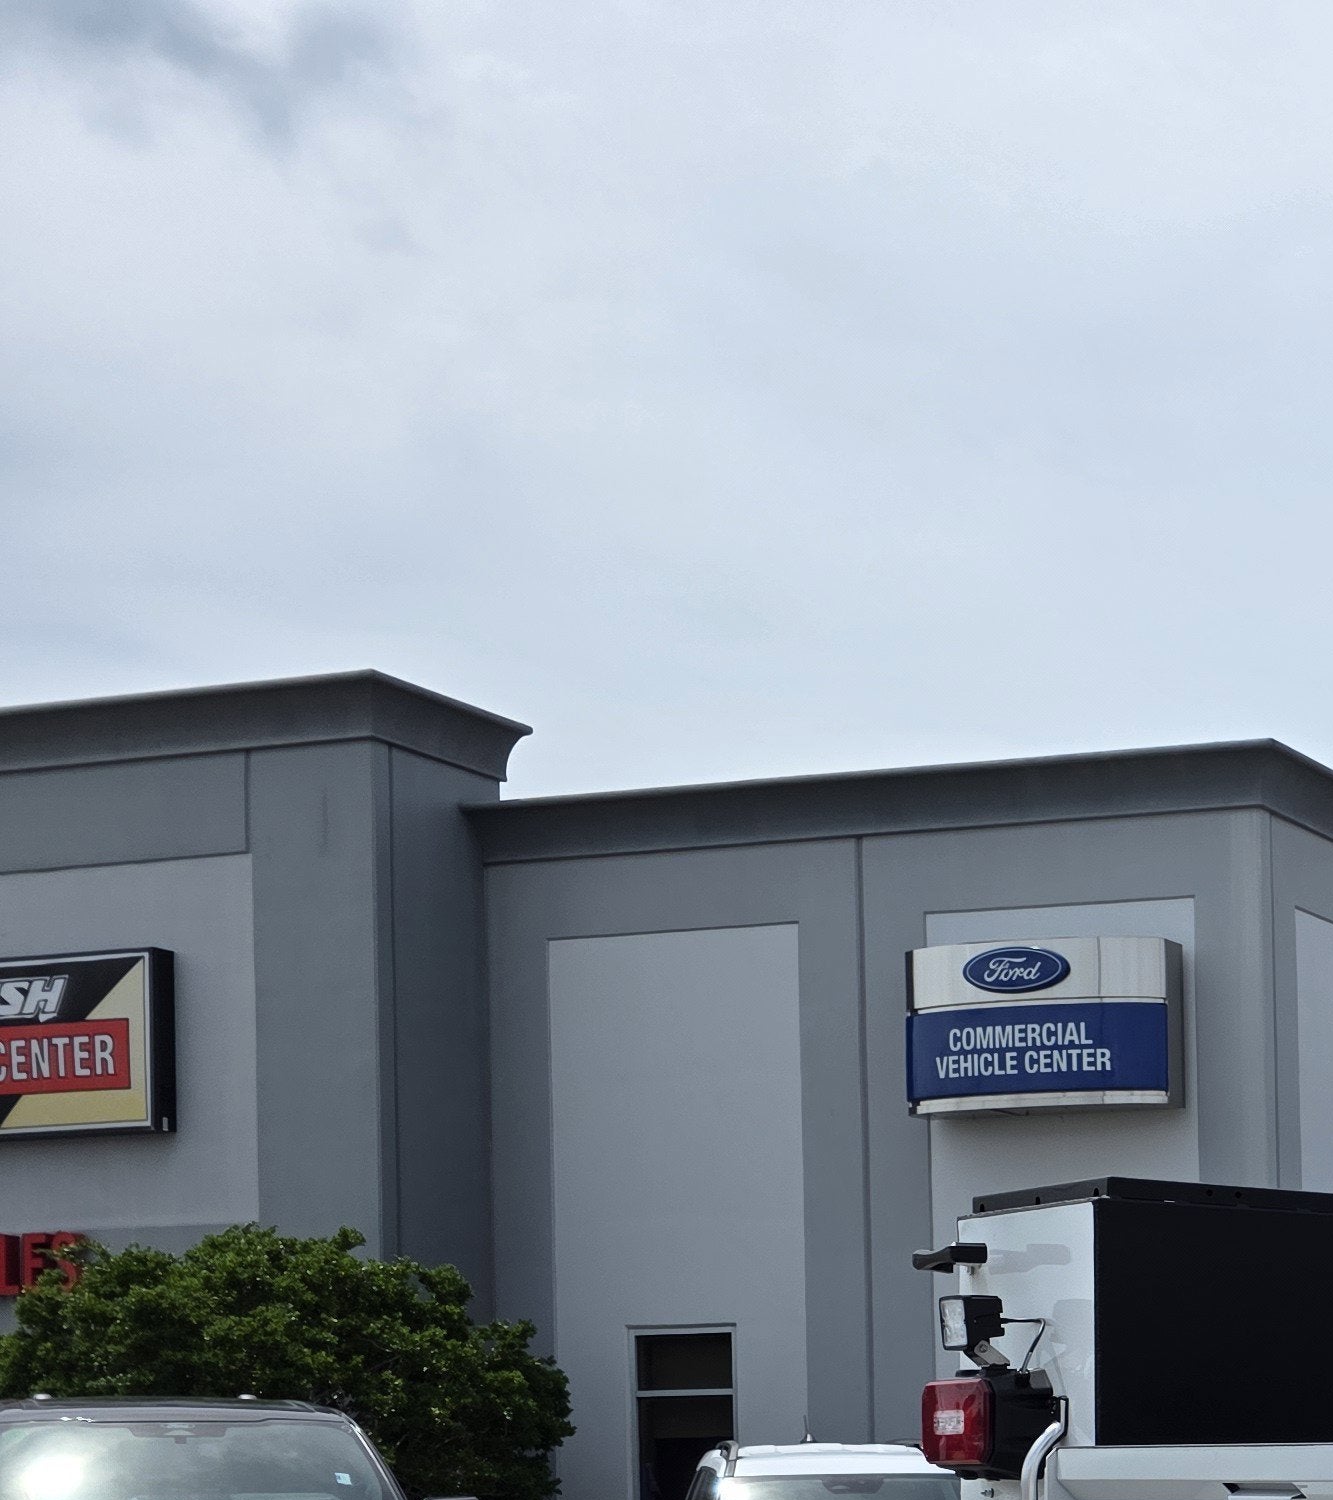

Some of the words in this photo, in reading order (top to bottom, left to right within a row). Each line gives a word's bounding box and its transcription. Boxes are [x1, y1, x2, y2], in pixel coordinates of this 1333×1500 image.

[983, 957, 1041, 983] Ford
[949, 1022, 1093, 1052] COMMERCIAL
[935, 1051, 1018, 1079] VEHICLE
[1024, 1048, 1112, 1073] CENTER
